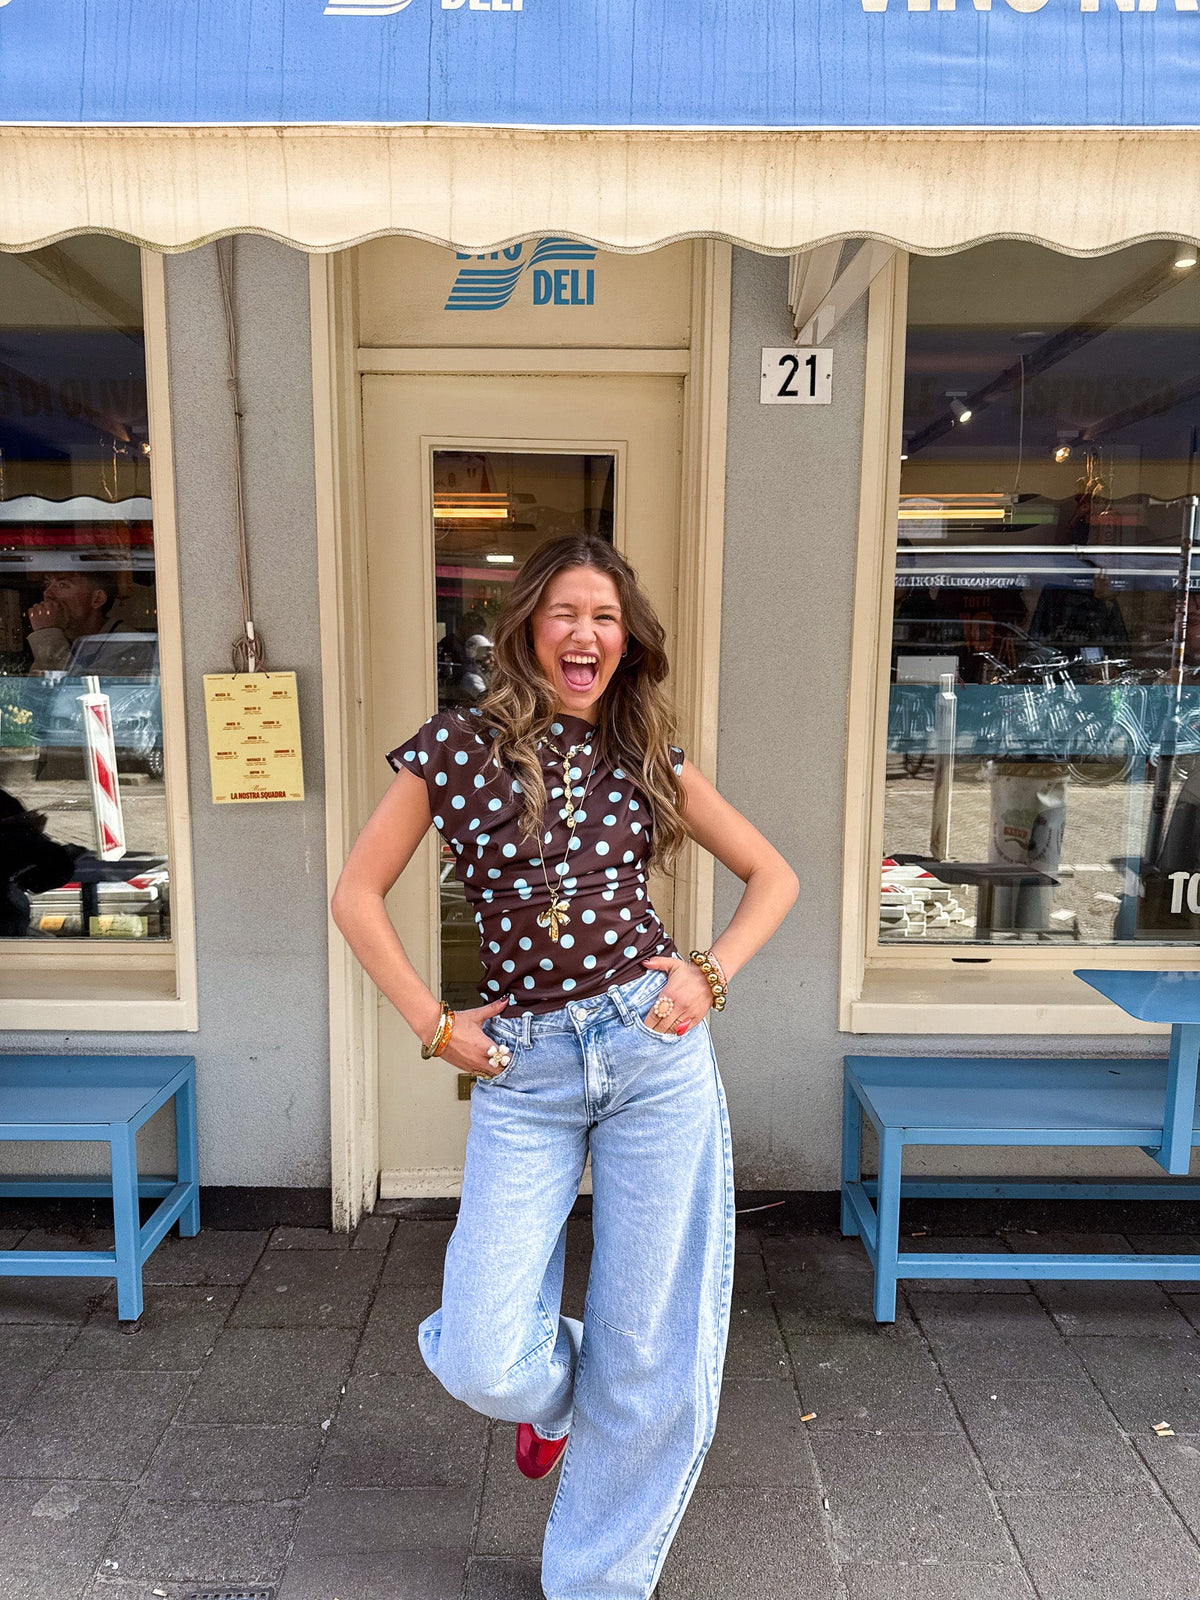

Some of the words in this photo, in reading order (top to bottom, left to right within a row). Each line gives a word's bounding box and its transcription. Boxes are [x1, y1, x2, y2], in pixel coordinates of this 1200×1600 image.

[533, 269, 595, 305] DELI
[777, 354, 817, 397] 21
[230, 792, 238, 800] LA
[238, 791, 260, 799] NOSTRA
[260, 790, 287, 799] SQUADRA
